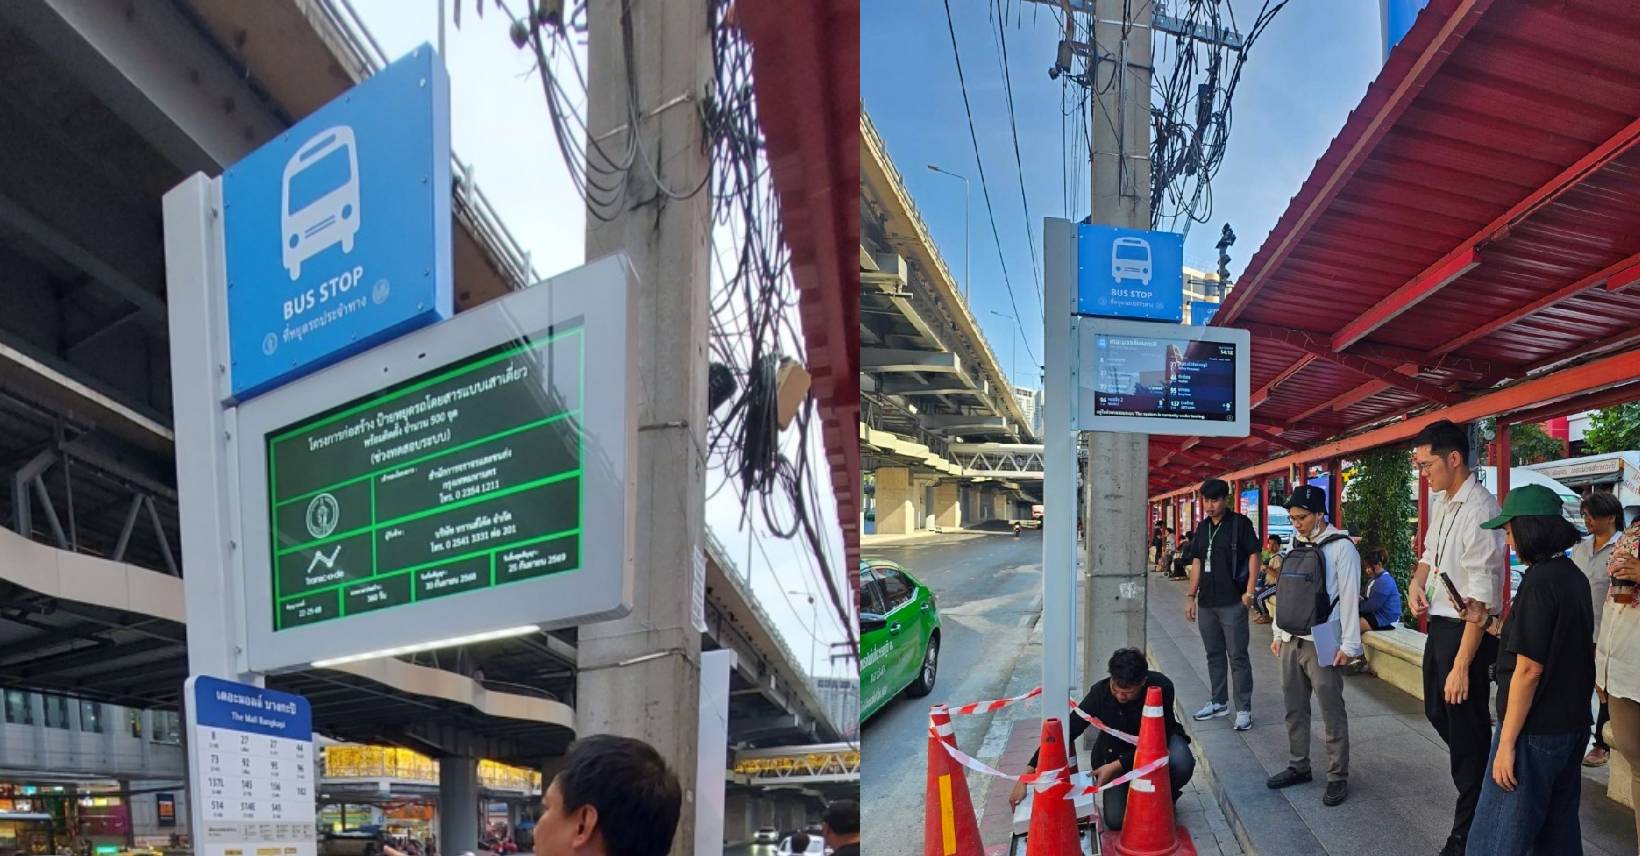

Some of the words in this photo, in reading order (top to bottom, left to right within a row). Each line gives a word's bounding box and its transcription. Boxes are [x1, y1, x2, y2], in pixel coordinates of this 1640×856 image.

[283, 289, 315, 320] BUS
[319, 265, 364, 304] STOP
[1111, 288, 1128, 297] BUS
[1130, 290, 1153, 299] STOP
[283, 296, 367, 343] ที่หยุดรถประจำทาง
[308, 419, 375, 451] โครงการก่อสร้าง
[377, 361, 528, 427] ป้ายหยุดรถโดยสารแบบเสาเดี่ยว
[429, 412, 446, 427] 500
[370, 429, 451, 465] (ช่วงทดสอบระบบ)
[440, 491, 454, 504] โทร.
[455, 490, 461, 500] 0
[461, 486, 480, 498] 2354
[482, 480, 500, 493] 1211
[445, 539, 452, 550] 0
[216, 689, 263, 708] เดอะมอลล์
[264, 700, 297, 715] บางกะปิ
[231, 711, 244, 721] The
[245, 713, 258, 723] Mall
[259, 715, 286, 729] Bangkapi
[241, 735, 249, 745] 27
[211, 754, 219, 764] 73
